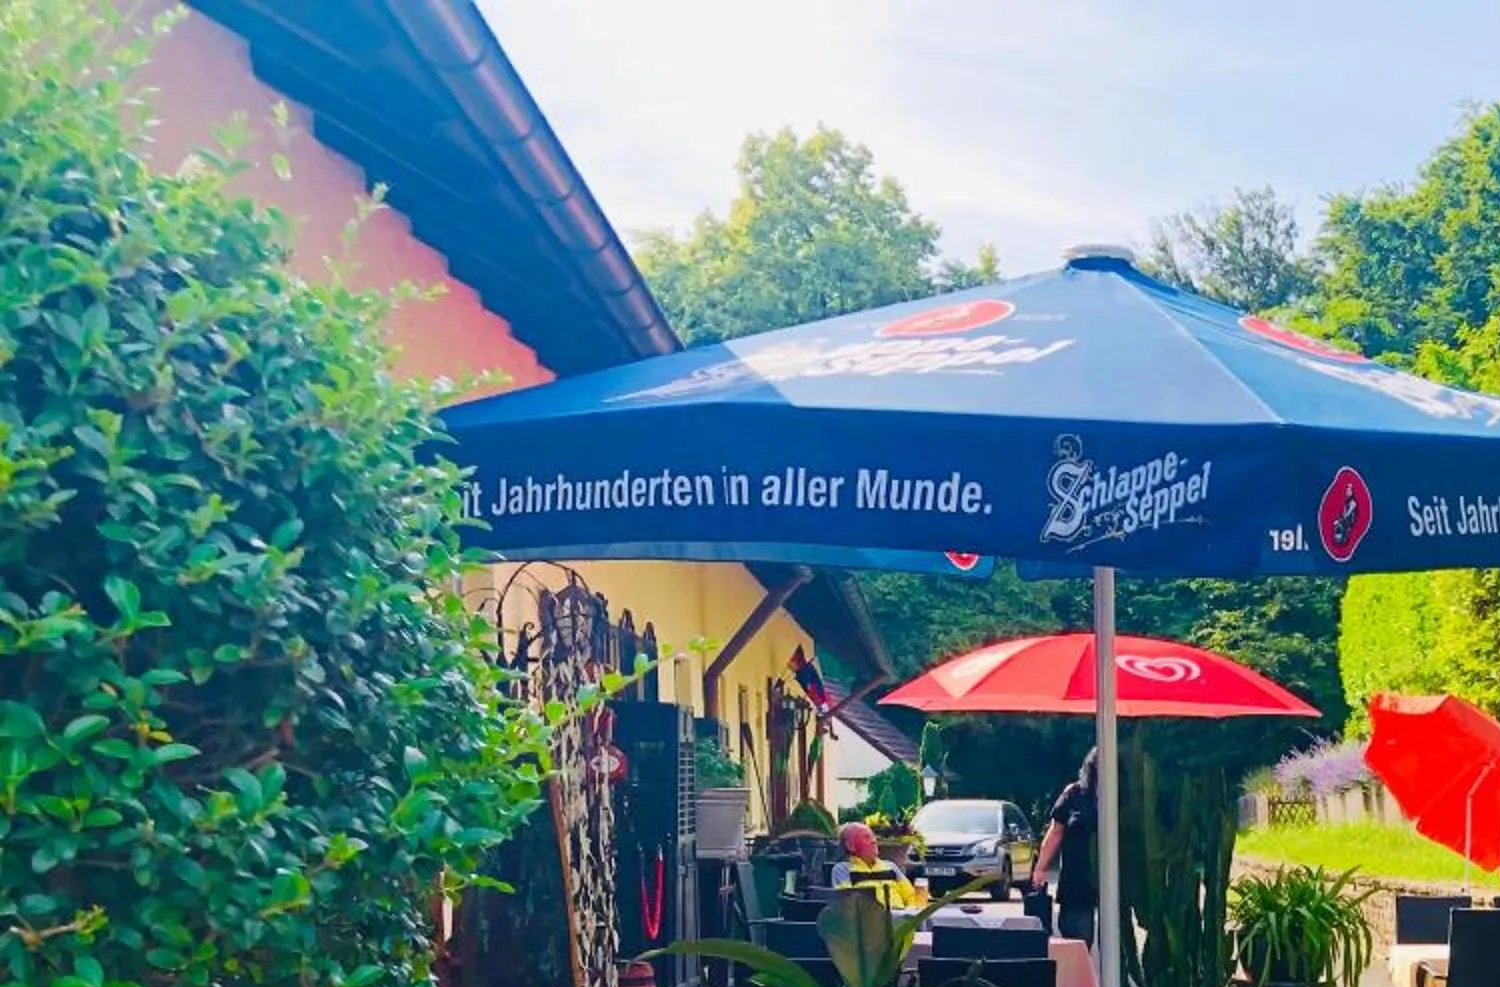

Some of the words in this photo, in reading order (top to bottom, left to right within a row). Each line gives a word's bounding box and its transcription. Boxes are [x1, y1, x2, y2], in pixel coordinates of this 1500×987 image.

[462, 481, 483, 518] it
[491, 469, 715, 517] Jahrhunderten
[721, 465, 749, 506] in
[761, 466, 845, 508] aller
[856, 468, 993, 515] Munde.
[1406, 495, 1453, 537] Seit
